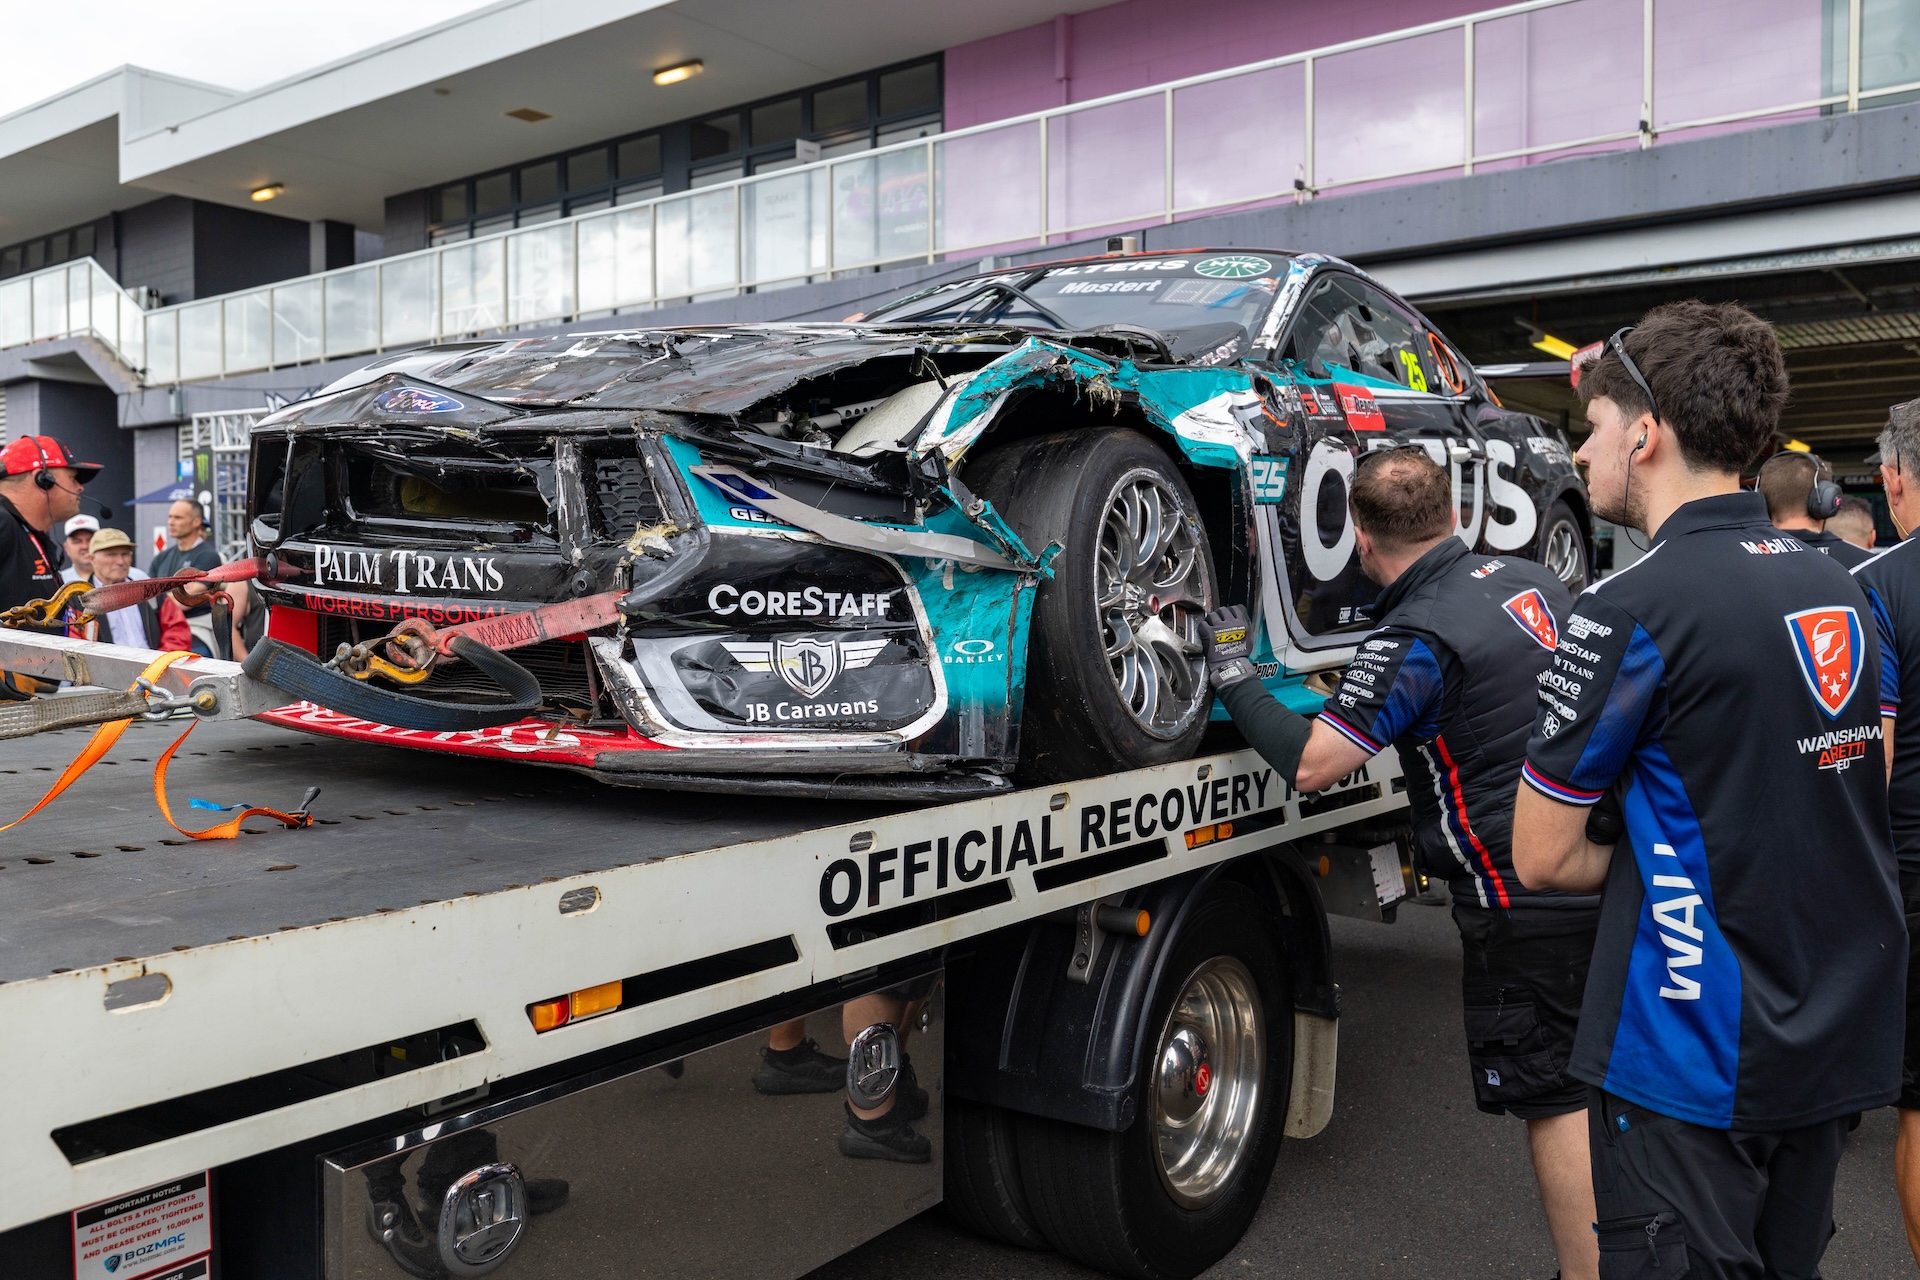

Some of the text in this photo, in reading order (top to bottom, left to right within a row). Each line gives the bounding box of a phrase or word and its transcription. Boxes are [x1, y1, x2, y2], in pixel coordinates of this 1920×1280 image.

[1211, 258, 1257, 269] NTK
[1057, 279, 1163, 295] Mostert
[1400, 350, 1427, 394] 25
[384, 388, 449, 410] Ford
[1301, 435, 1538, 582] OUS
[1739, 539, 1790, 555] Mobil
[313, 544, 505, 594] PALM TRANS
[1470, 562, 1501, 579] Mobil
[305, 592, 385, 619] MORRIS
[788, 648, 827, 688] JB
[944, 653, 1004, 664] OAKLEY
[1562, 659, 1596, 681] TRANS
[745, 699, 880, 723] JB Caravans
[819, 815, 1064, 917] OFFICIAL
[1079, 768, 1272, 853] RECOVERY
[89, 1225, 105, 1235] ALL
[107, 1215, 133, 1229] BOLTS
[143, 1203, 167, 1217] PIVOT
[167, 1193, 197, 1208] POINTS
[104, 1184, 182, 1216] IMPORTANT NOTICE
[81, 1202, 204, 1248] MUST BE CHECKED, TIGHTENED
[83, 1213, 204, 1261] AND GREASE EVERY 10,000 KM
[121, 1244, 186, 1270] www.bozmac.com.au
[124, 1232, 187, 1262] BOZMAC
